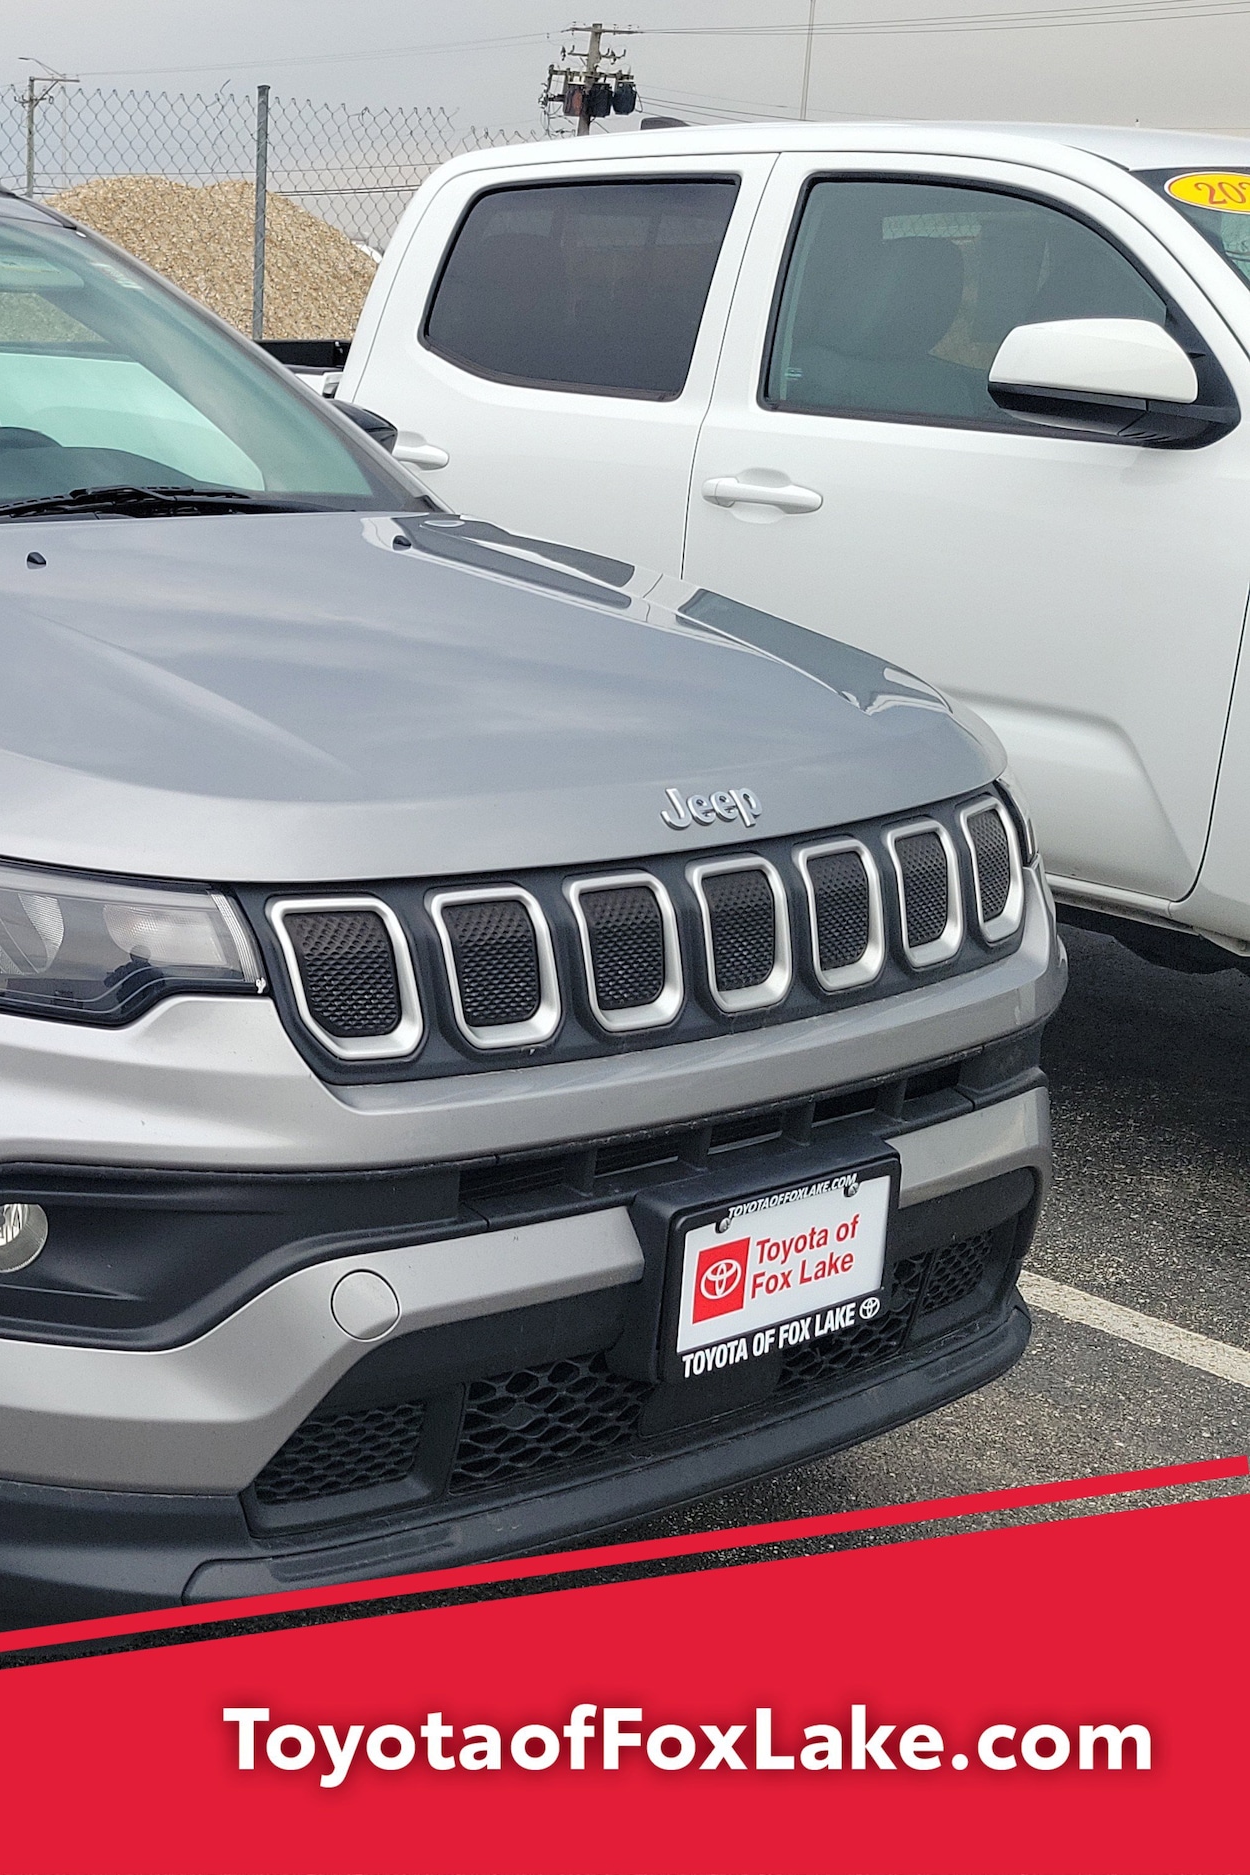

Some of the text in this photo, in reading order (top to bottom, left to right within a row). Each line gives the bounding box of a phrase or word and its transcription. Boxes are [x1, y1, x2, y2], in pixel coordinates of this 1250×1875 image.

[660, 787, 763, 830] Jeep
[728, 1172, 858, 1219] TOYOTAOFFOXLAKE.COM
[755, 1213, 861, 1266] Toyota of
[751, 1251, 855, 1300] Fox Lake
[682, 1302, 857, 1379] TOYOTA OF FOX LAKE
